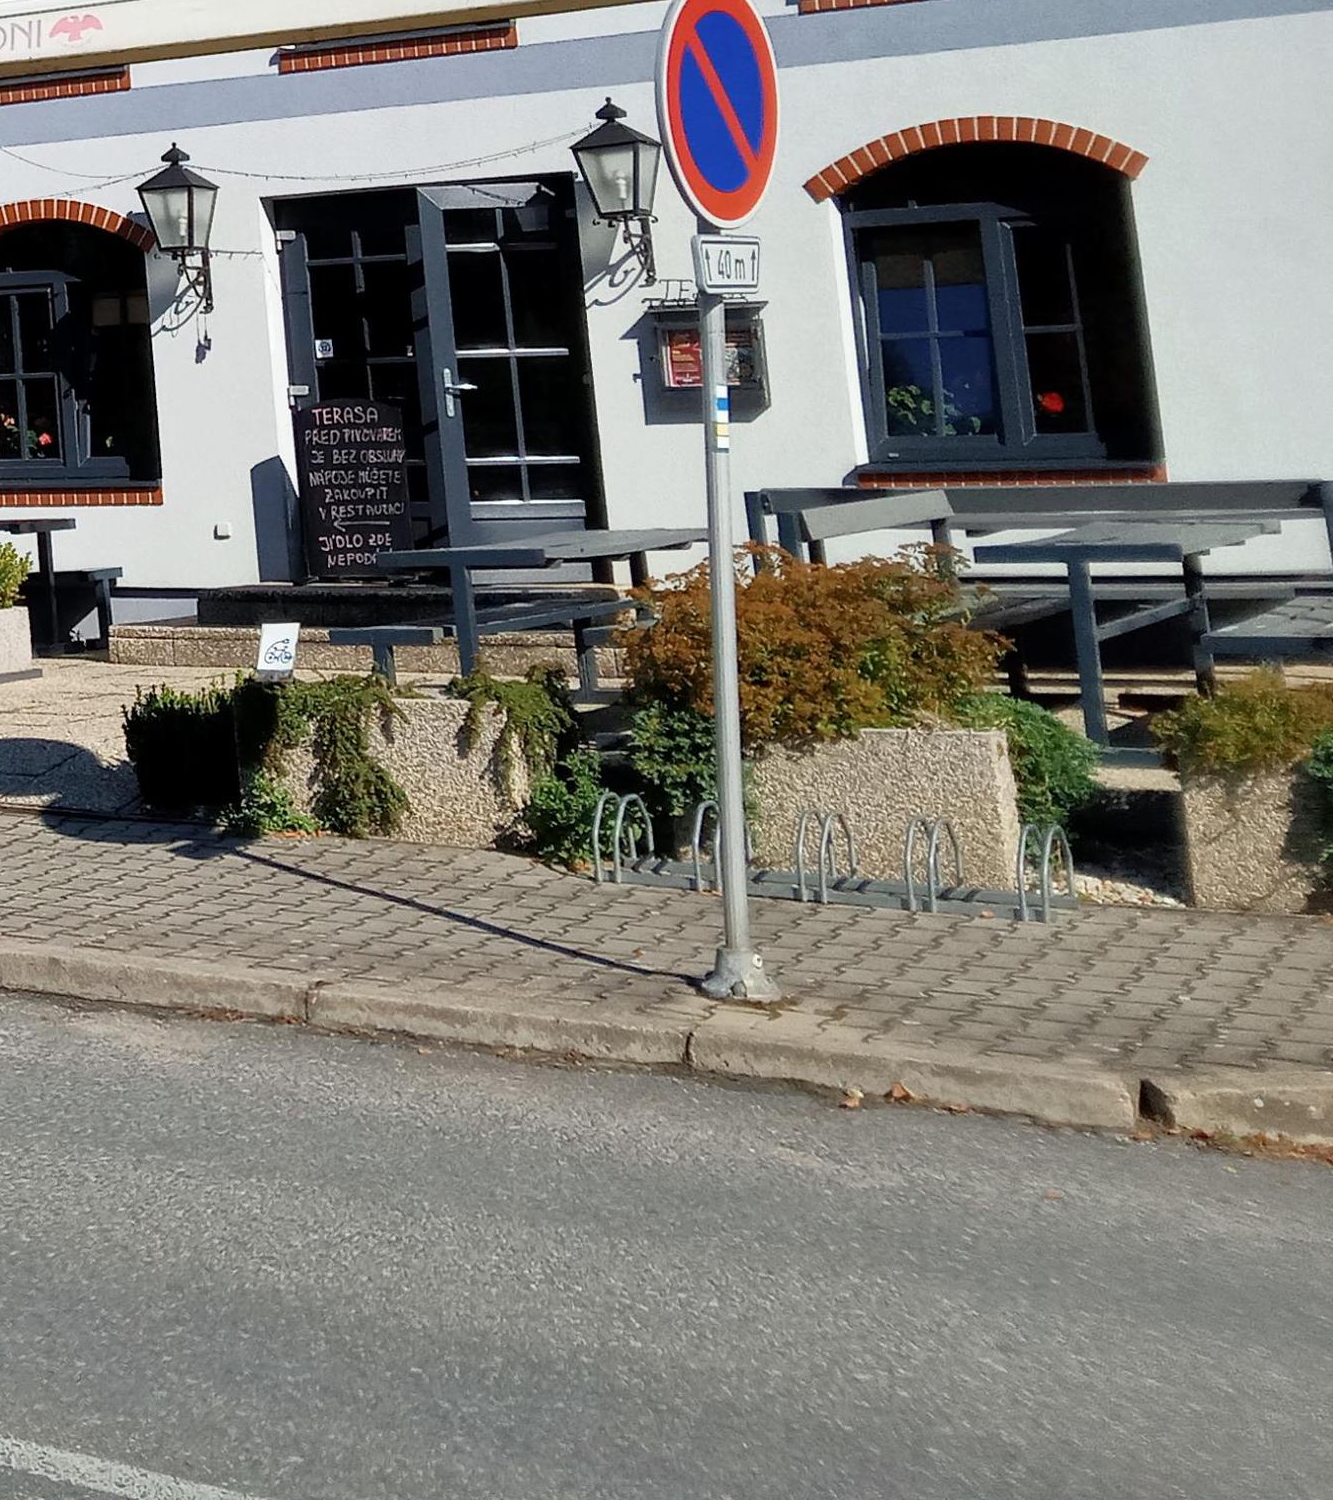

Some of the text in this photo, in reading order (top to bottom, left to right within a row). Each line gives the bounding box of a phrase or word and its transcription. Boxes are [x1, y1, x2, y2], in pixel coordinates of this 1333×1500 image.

[717, 249, 746, 280] 40 m
[311, 406, 378, 425] TERASA
[333, 449, 357, 464] BEZ
[324, 487, 388, 503] ZAKOUPIT
[318, 533, 392, 551] JÍDLO ZDE
